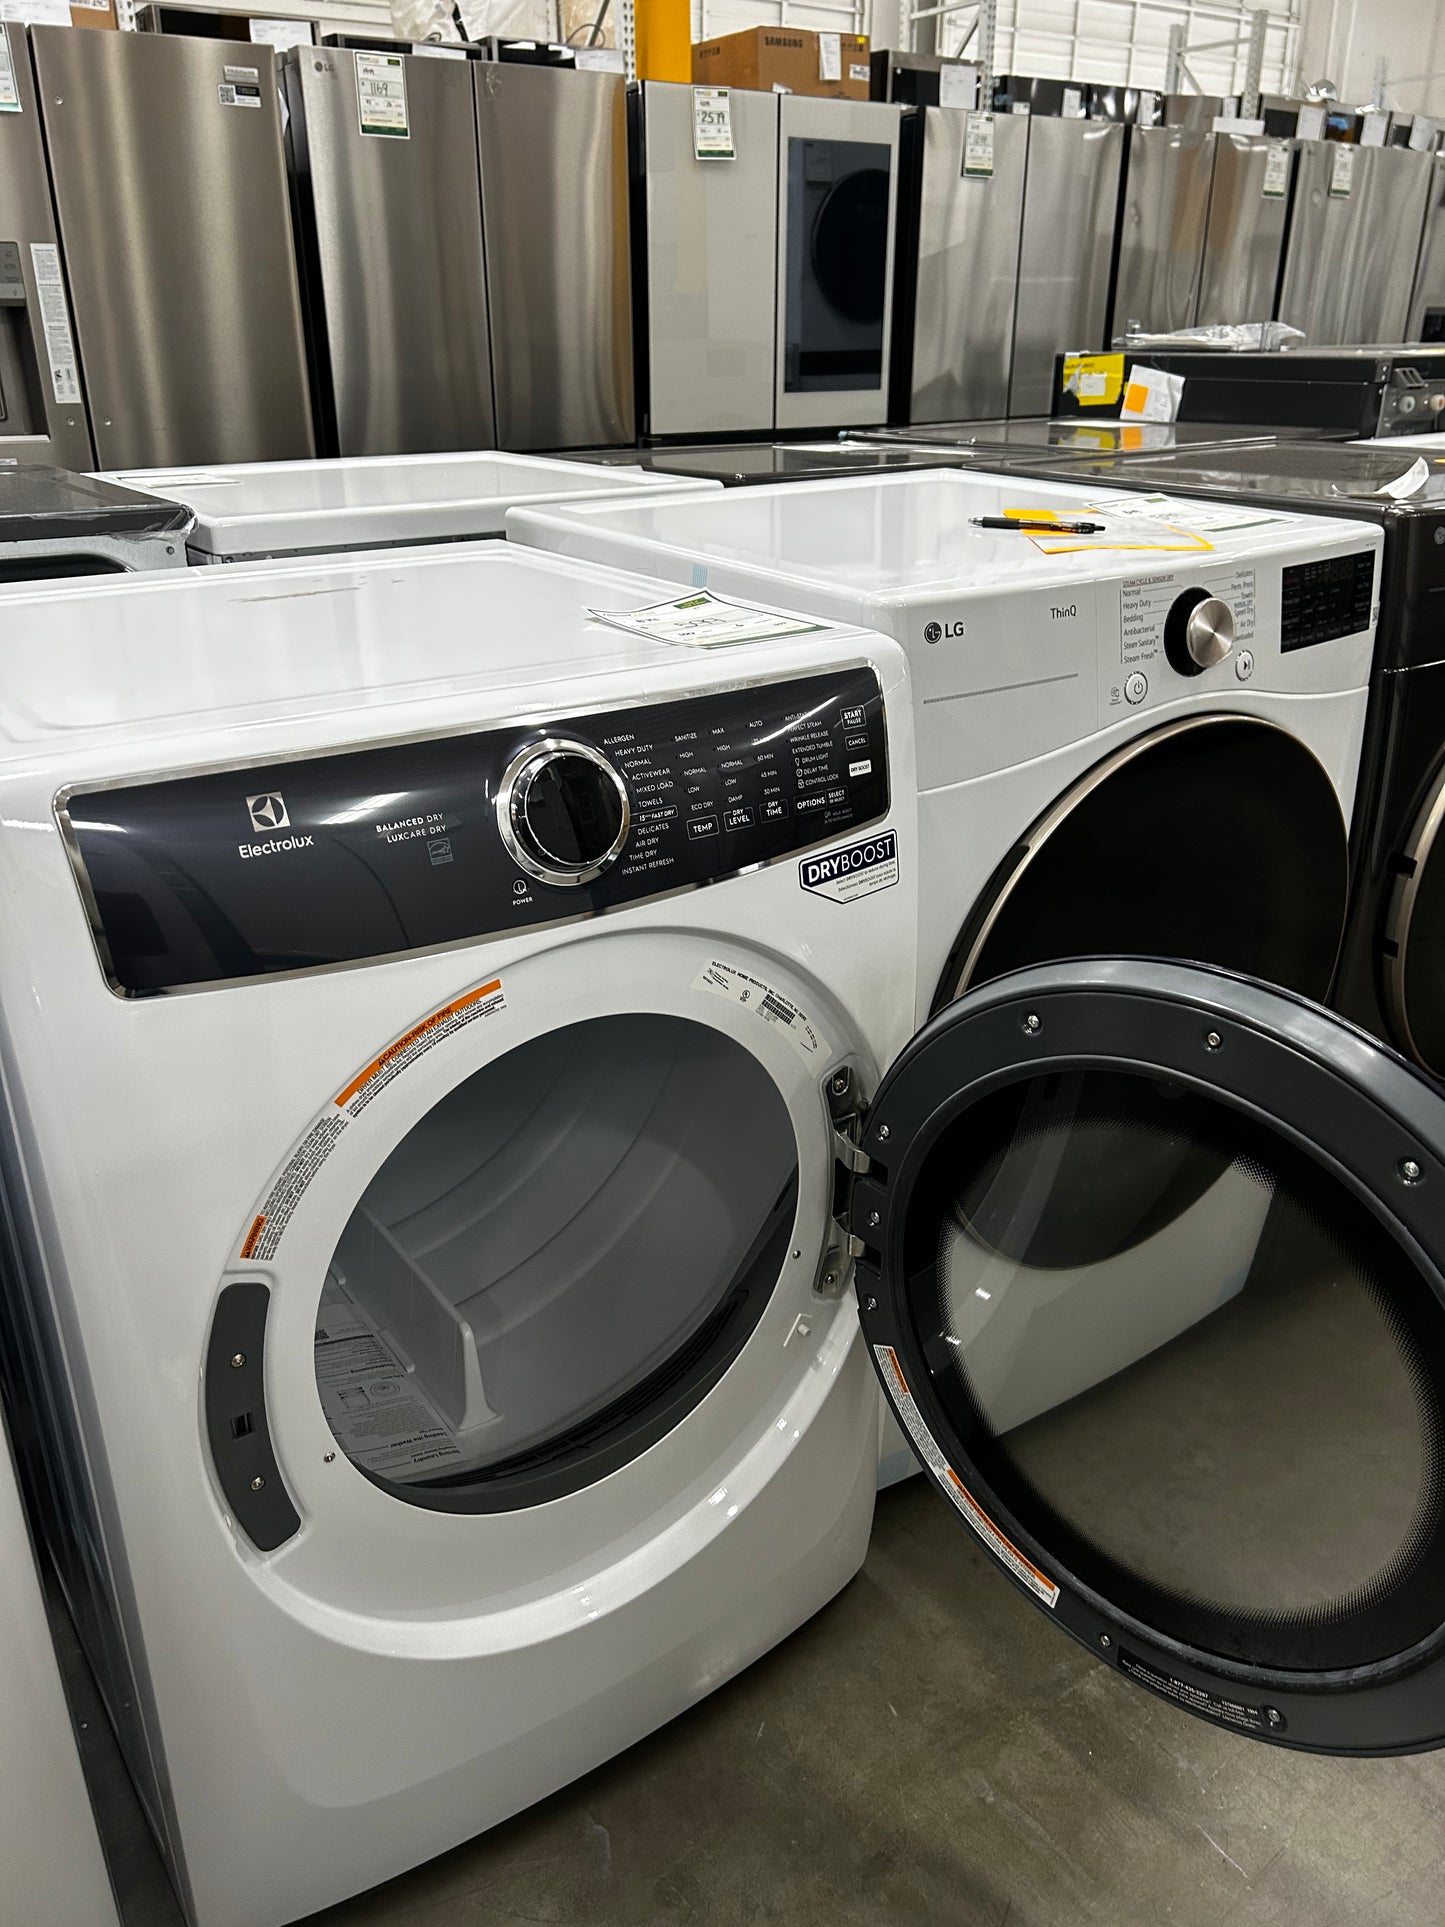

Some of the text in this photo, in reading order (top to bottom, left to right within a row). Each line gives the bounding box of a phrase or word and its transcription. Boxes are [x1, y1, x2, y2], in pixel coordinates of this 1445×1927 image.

[1123, 588, 1141, 598] Normal
[1123, 599, 1151, 610] Heavy Duty
[1050, 604, 1077, 619] ThinQ
[1123, 615, 1144, 623] Bedding
[944, 621, 964, 638] LG
[1123, 625, 1155, 636] Antibacterial
[1124, 641, 1138, 650] Steam
[1124, 655, 1140, 664] Steam
[844, 710, 862, 719] START
[749, 720, 763, 728] AUTO
[807, 721, 822, 729] STEAM
[604, 734, 635, 745] ALLERGEN
[675, 732, 698, 742] SANITIZE
[790, 730, 829, 743] WRINKLE RELEASE
[848, 738, 866, 746] CANCEL
[615, 744, 653, 757] HEAVY DUTY
[792, 740, 833, 754] EXTENDED TUMBLE
[624, 758, 652, 768] NORMAL
[802, 752, 829, 764] DRUM LIGHT
[721, 760, 743, 768] NORMAL
[632, 768, 671, 781] ACTIVEWEAR
[684, 767, 707, 776] NORMAL
[804, 767, 818, 775] DELAY
[725, 778, 736, 786] LOW
[805, 773, 839, 786] CONTROL LOCK
[636, 781, 674, 794] MIXED LOAD
[688, 786, 700, 794] LOW
[728, 794, 743, 803] DAMP
[828, 789, 845, 798] SELECT
[638, 797, 663, 808] TOWELS
[691, 803, 702, 811] ECO
[797, 797, 825, 810] OPTIONS
[651, 811, 663, 819] FAST
[664, 809, 675, 817] DRY
[733, 808, 744, 816] DRY
[766, 806, 782, 816] TIME
[376, 813, 443, 832] BALANCED DRY
[729, 814, 750, 825] LEVEL
[637, 822, 669, 836] DELICATES
[693, 822, 713, 833] TEMP
[387, 824, 446, 843] LUXCARE DRY
[238, 835, 314, 859] Electrolux
[636, 837, 659, 848] AIR DRY
[629, 849, 657, 861] TIME DRY
[808, 838, 892, 883] DRYBOOST
[622, 857, 674, 876] INSTANT REFRESH
[512, 896, 533, 906] POWER
[712, 961, 737, 975] ELECTROLUX
[737, 972, 749, 980] HOME
[427, 1017, 437, 1026] OF
[437, 1007, 452, 1020] FIRE
[245, 1217, 264, 1253] WARNING
[414, 1453, 439, 1462] Laundry
